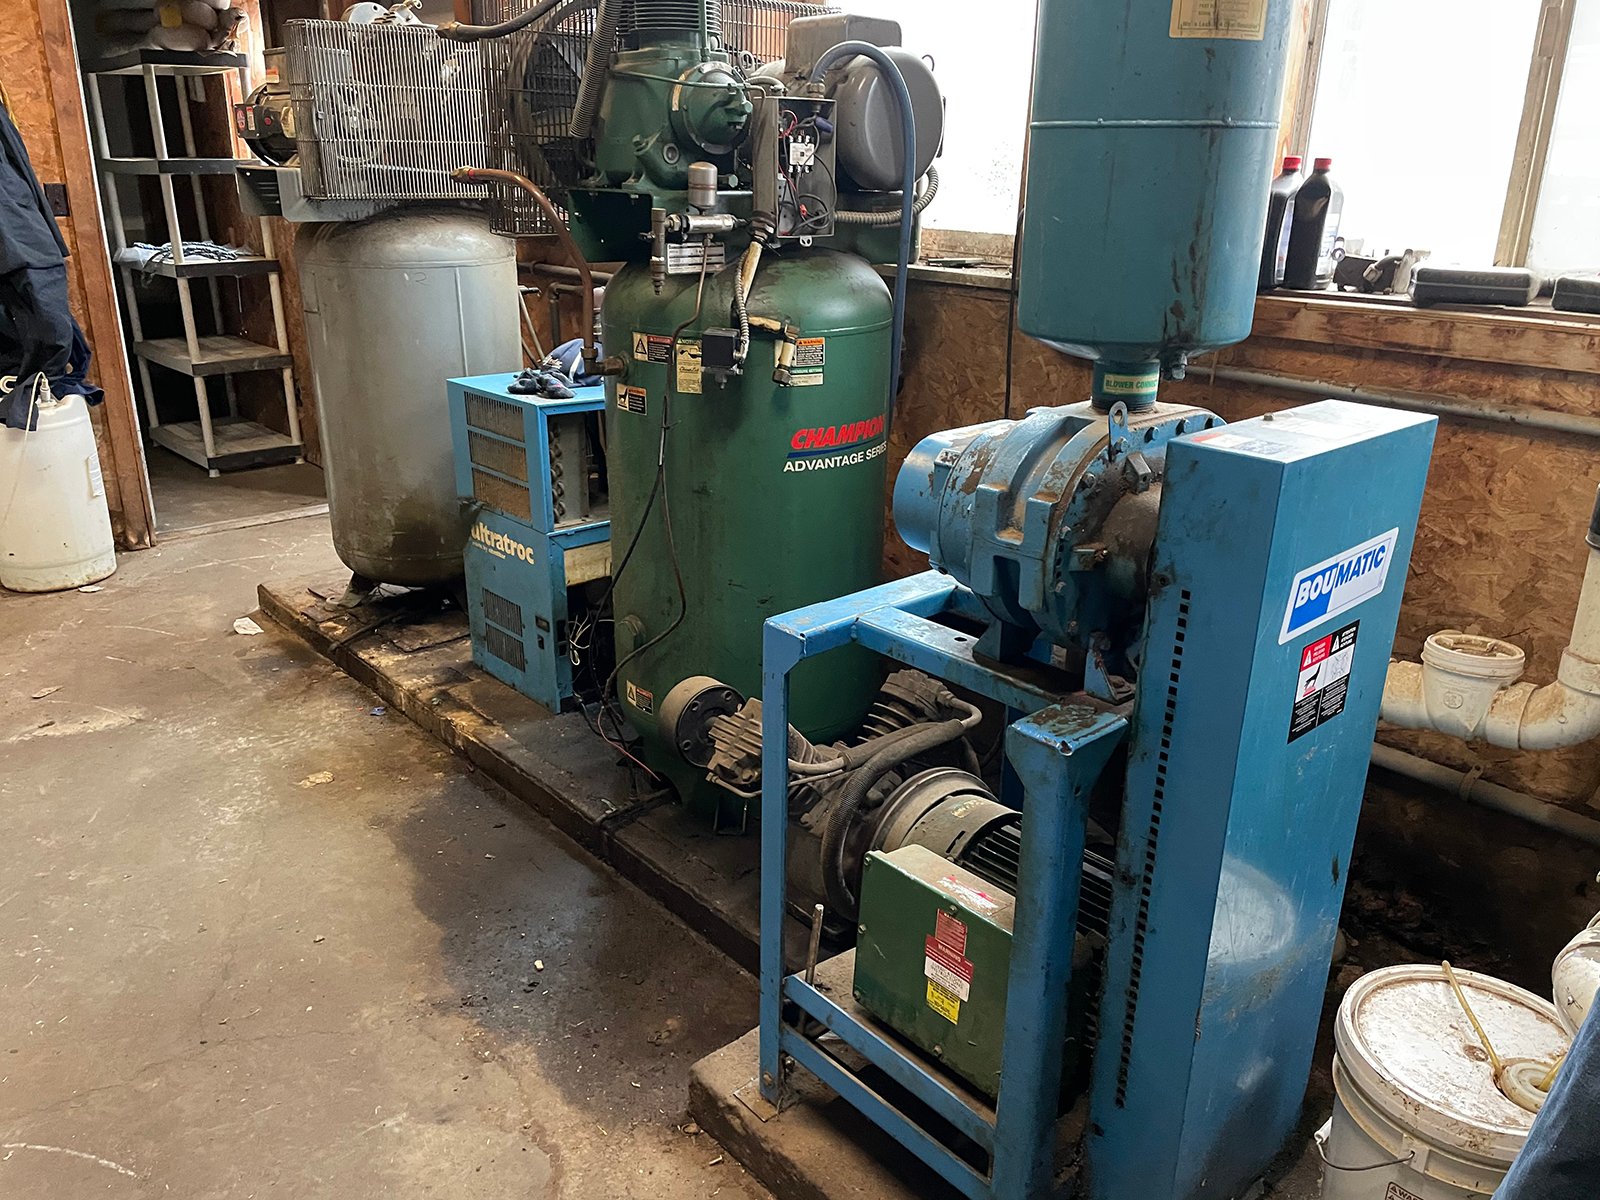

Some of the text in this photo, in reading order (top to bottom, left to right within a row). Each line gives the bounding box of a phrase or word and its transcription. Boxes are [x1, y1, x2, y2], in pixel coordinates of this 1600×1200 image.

[1105, 379, 1134, 389] BLOWER
[790, 416, 885, 449] CHAMPION
[783, 440, 887, 473] ADVANTAGE SERIES
[471, 522, 535, 565] ultratroc
[1294, 544, 1386, 609] BOUMATIC
